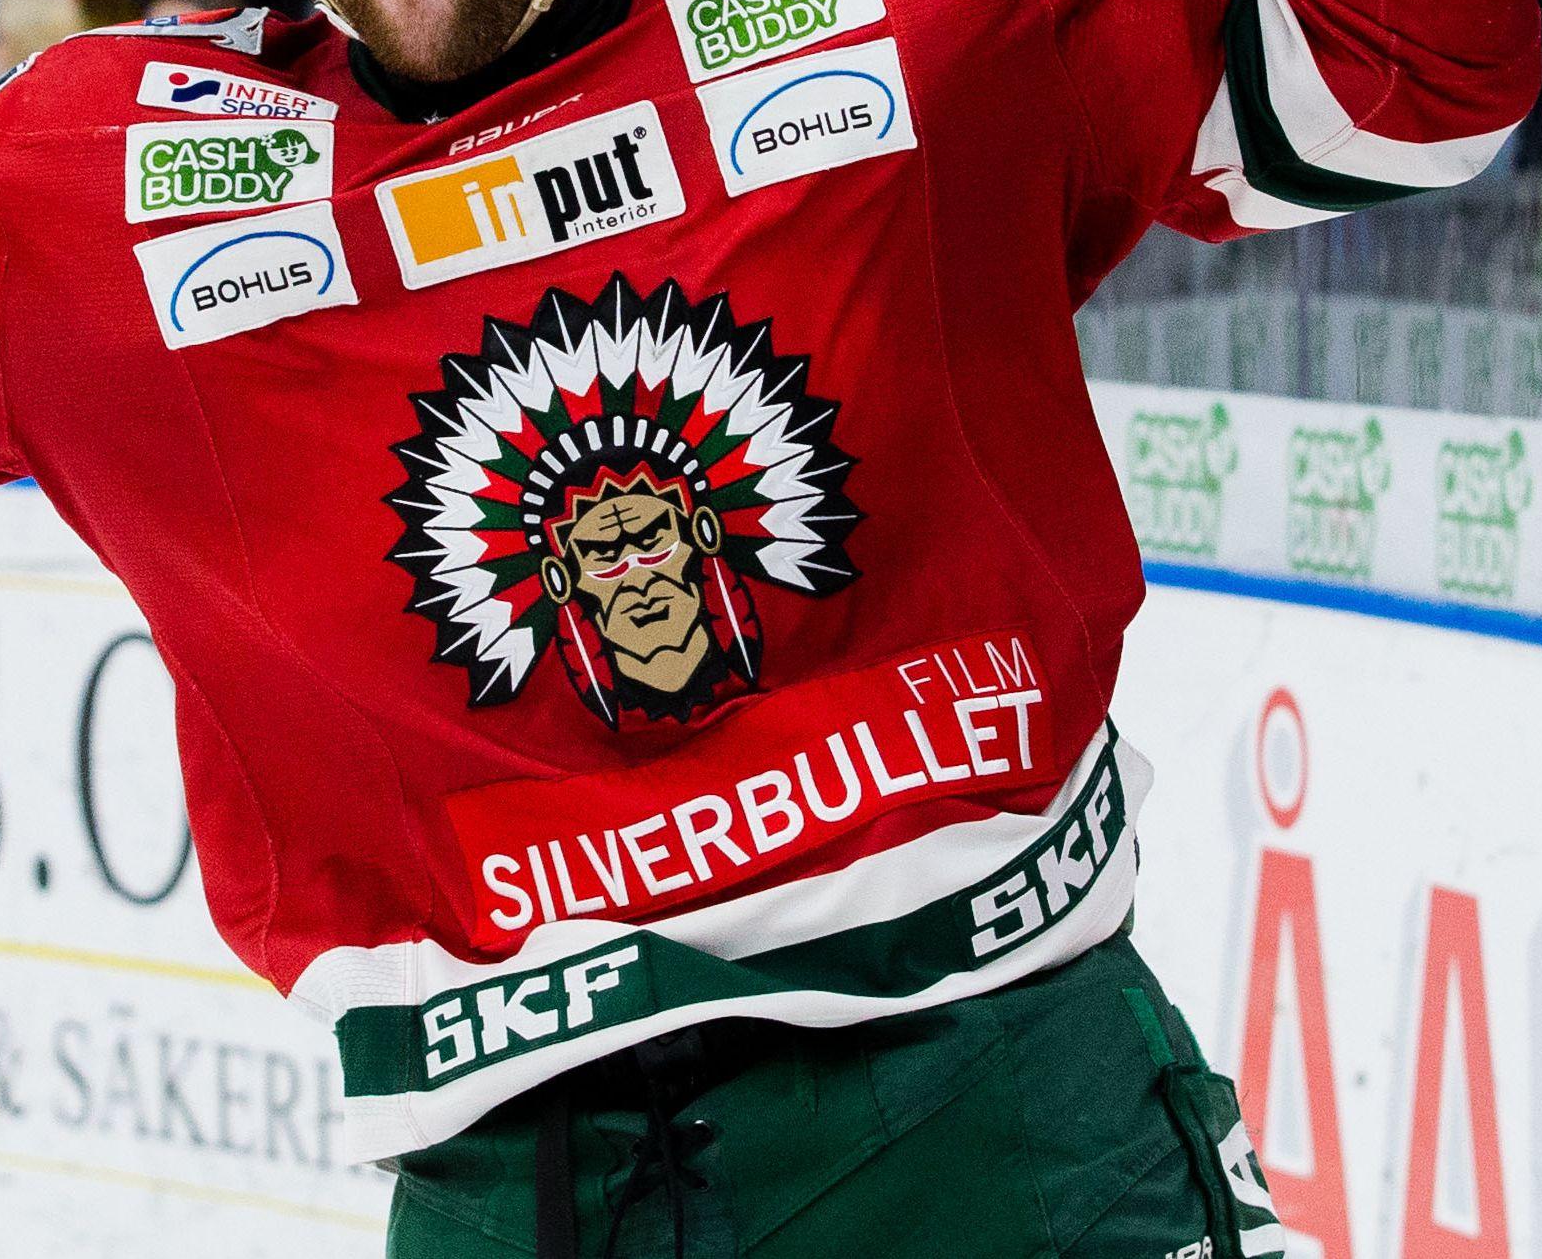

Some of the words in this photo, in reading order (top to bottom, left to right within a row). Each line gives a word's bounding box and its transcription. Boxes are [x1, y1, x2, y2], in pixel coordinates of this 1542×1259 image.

[220, 97, 307, 119] SPORT
[225, 81, 311, 111] INTER
[752, 103, 874, 155] BOHUS
[145, 140, 257, 174] CASH
[145, 171, 289, 207] BUDDY
[462, 132, 654, 247] input
[573, 202, 658, 237] interiör
[191, 261, 313, 312] BOHUS
[899, 635, 1038, 705] FILM
[480, 688, 1044, 931] SILVERBULLET
[970, 763, 1117, 959] SKF
[423, 944, 640, 1080] SKF
